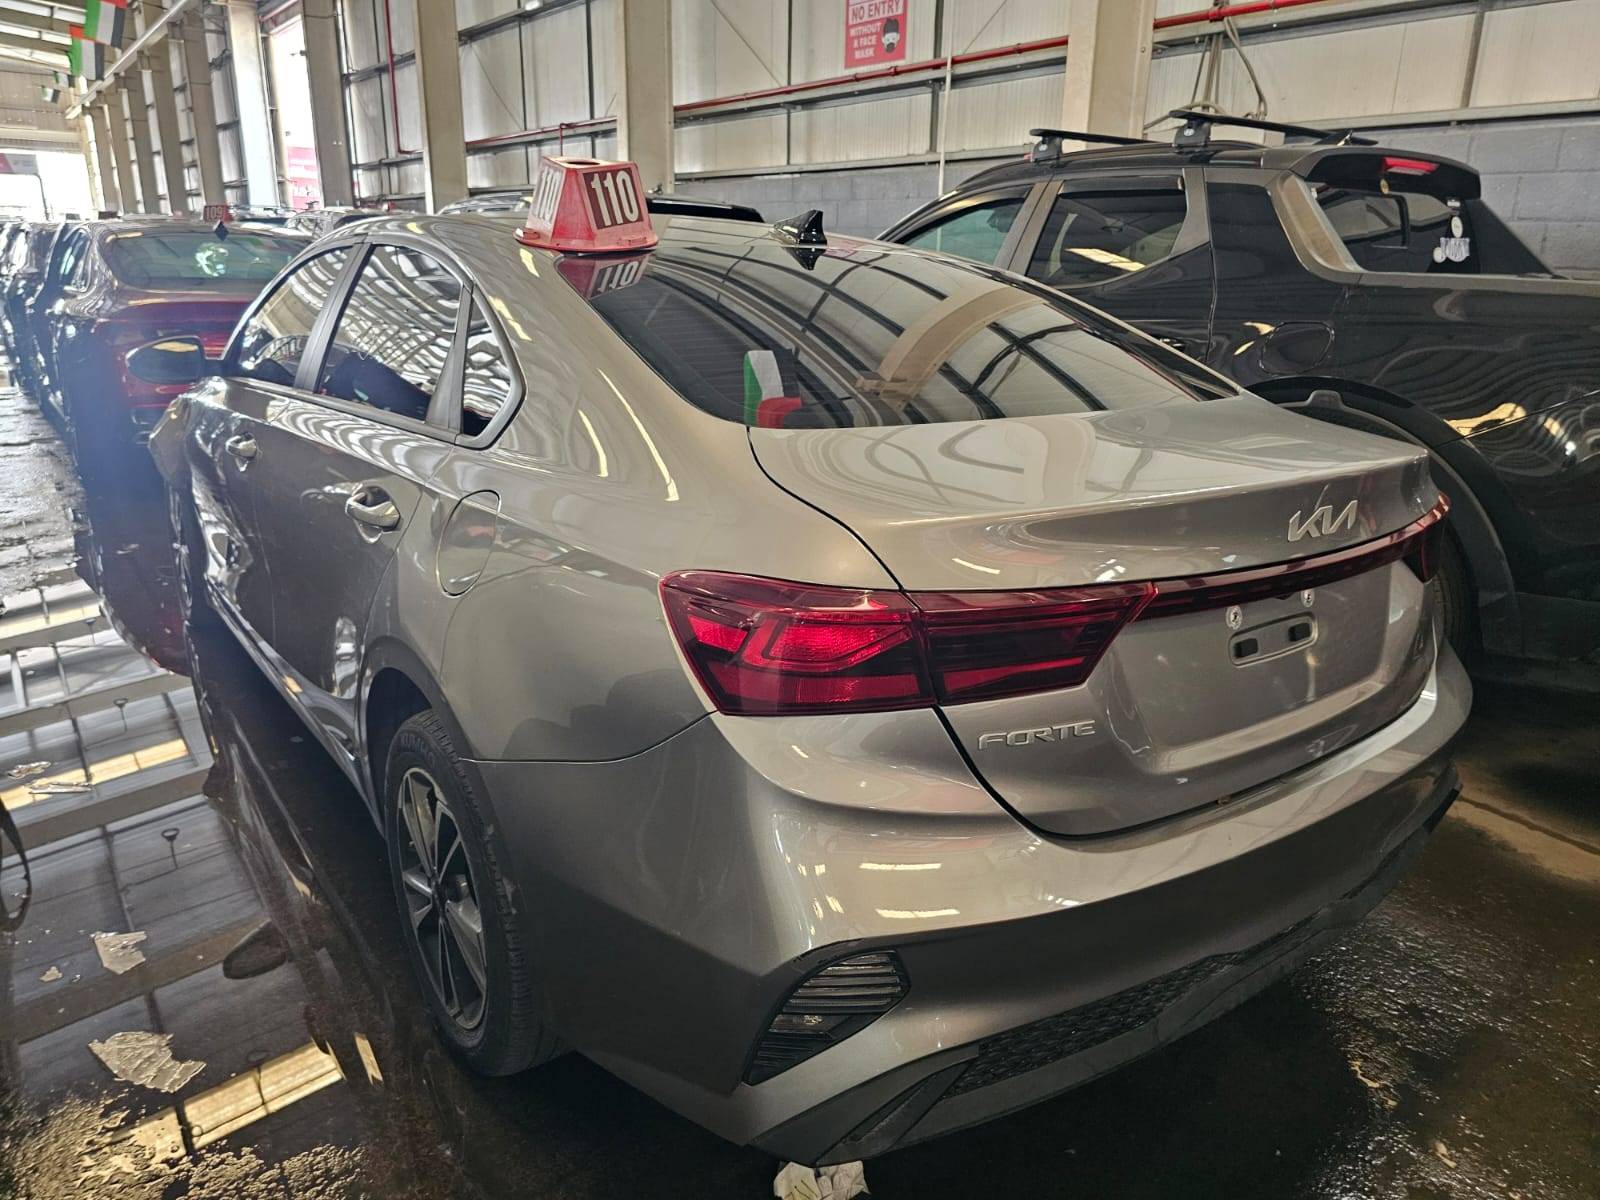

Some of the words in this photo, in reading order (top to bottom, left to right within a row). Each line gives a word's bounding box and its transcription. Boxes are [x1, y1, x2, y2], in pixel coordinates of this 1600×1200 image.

[852, 5, 865, 22] NO
[868, 0, 900, 18] ENTRY
[850, 23, 881, 37] WITHOUT
[860, 35, 877, 47] FACE
[535, 165, 563, 223] 110
[591, 170, 640, 227] 110
[206, 206, 224, 220] 109
[1287, 499, 1359, 542] KIA
[978, 719, 1096, 750] FORTE
